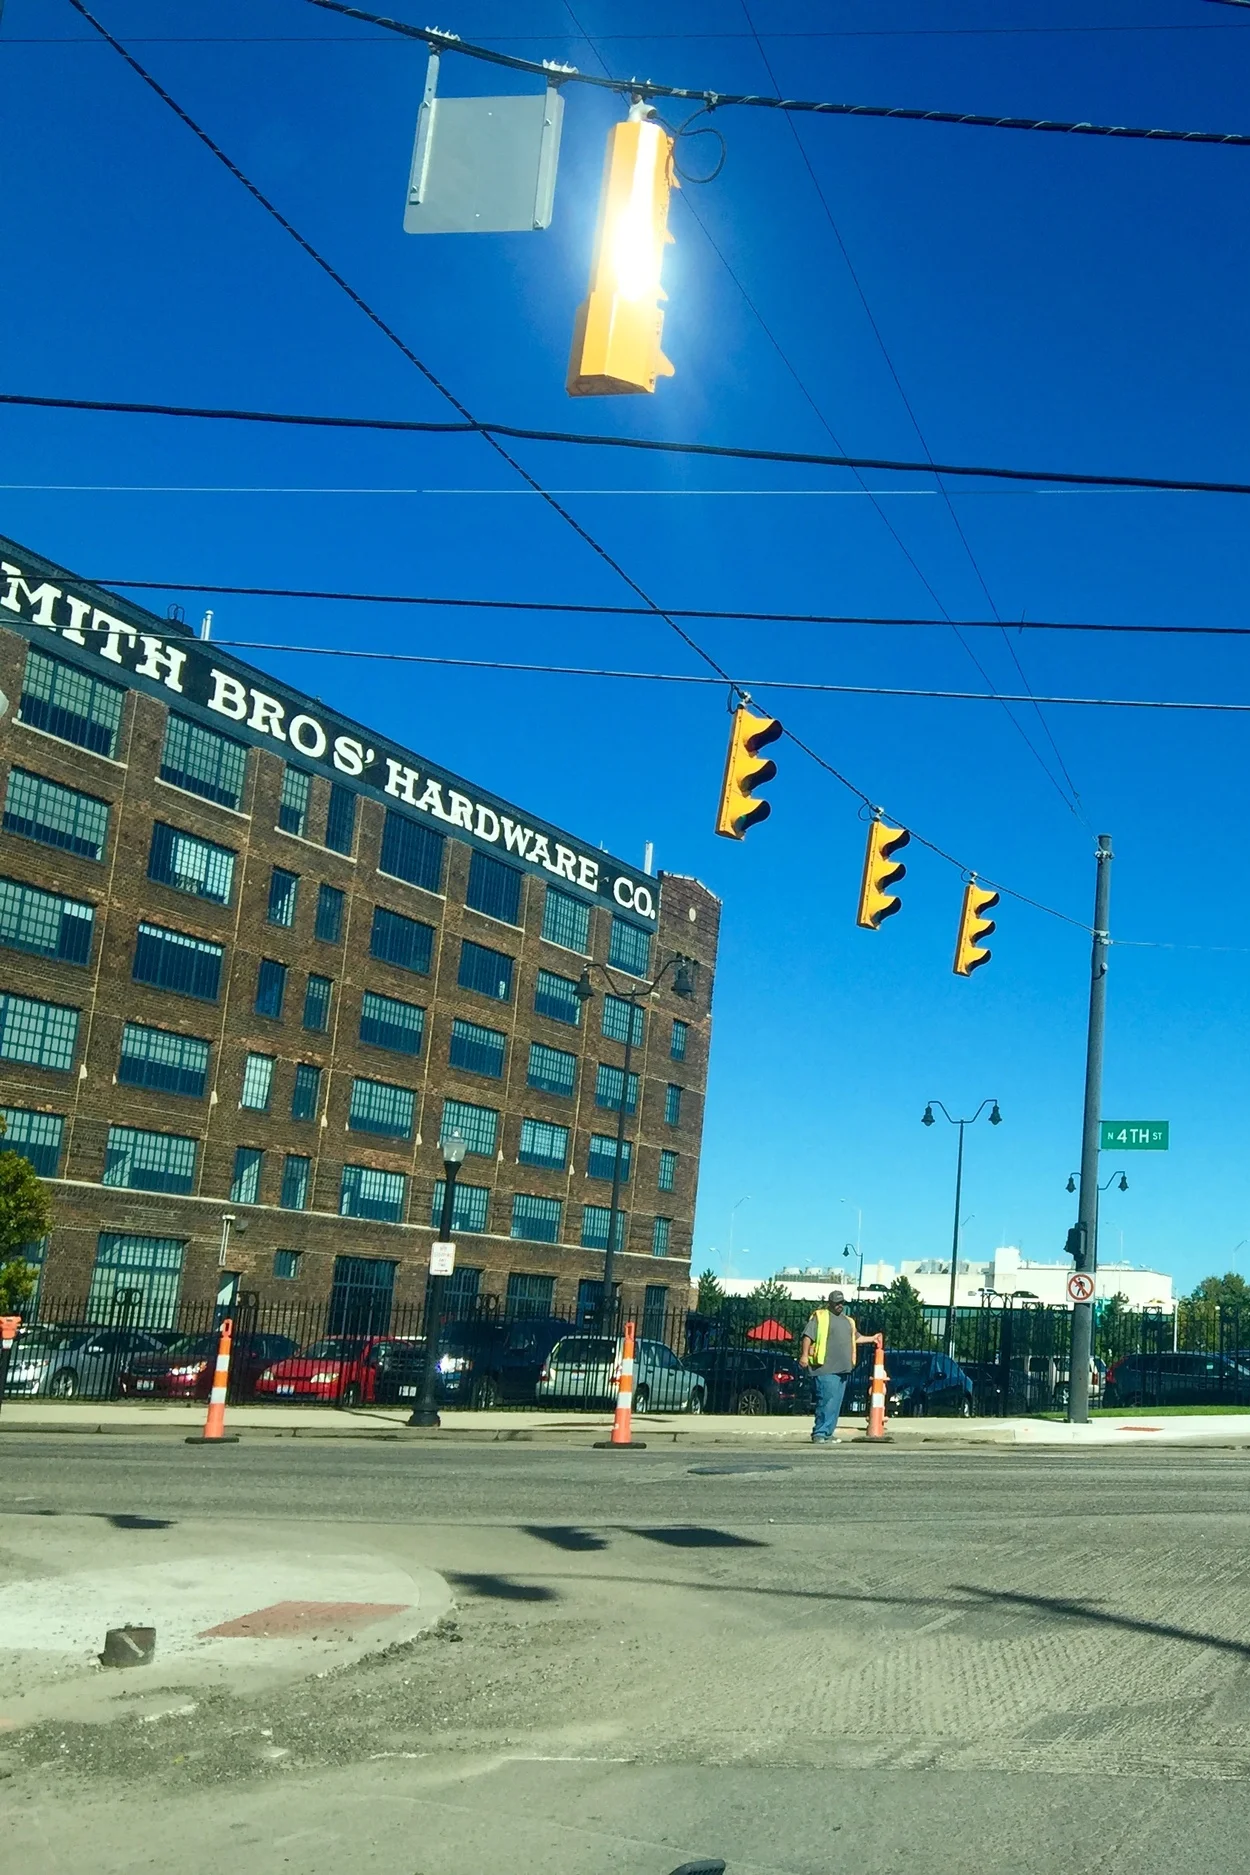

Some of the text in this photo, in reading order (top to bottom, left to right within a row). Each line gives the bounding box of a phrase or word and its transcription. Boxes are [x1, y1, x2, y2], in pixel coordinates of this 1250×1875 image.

[207, 668, 375, 776] BROS'
[384, 757, 599, 893] HARDWARE
[613, 877, 656, 920] CO.
[1107, 1128, 1163, 1143] N 4TH ST
